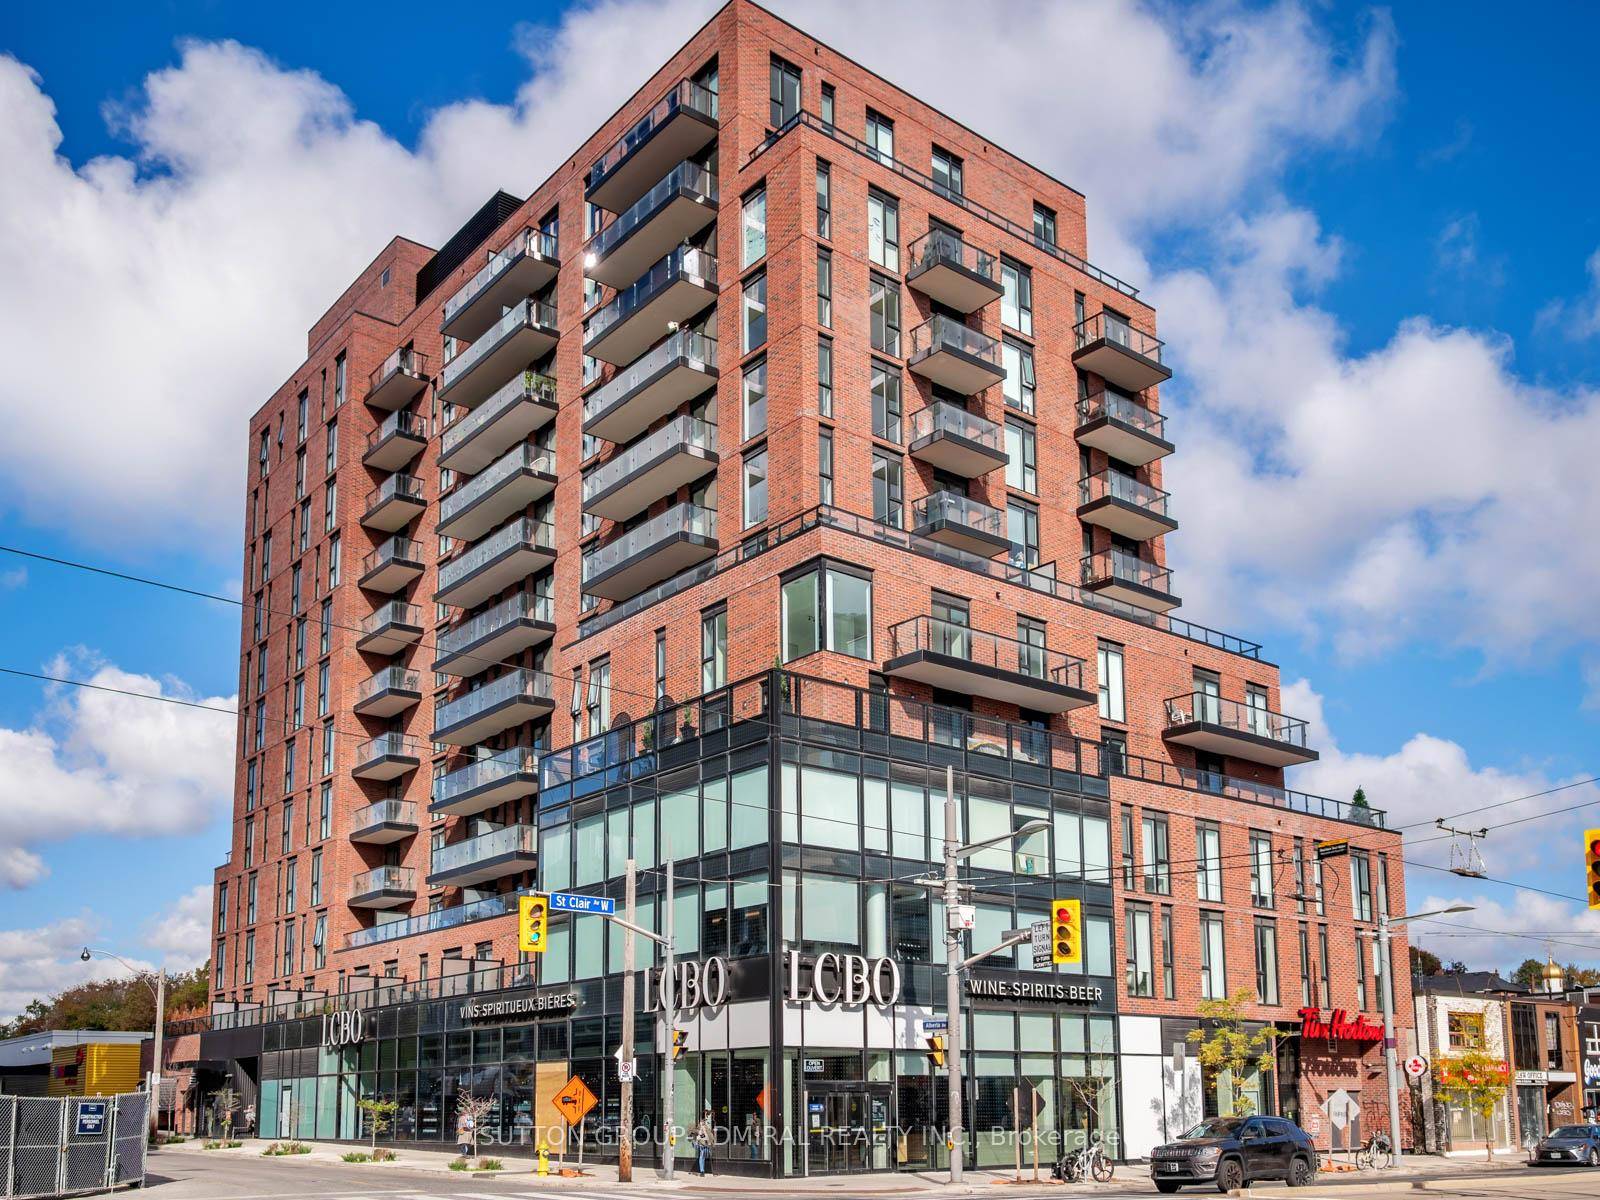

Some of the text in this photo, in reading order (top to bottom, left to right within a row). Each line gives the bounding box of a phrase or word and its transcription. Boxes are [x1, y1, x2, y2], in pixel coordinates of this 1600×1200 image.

[556, 895, 566, 907] St
[569, 897, 591, 909] Clair
[601, 901, 609, 911] W
[1034, 923, 1050, 933] LEFT
[1034, 934, 1050, 943] TURN
[643, 956, 725, 1014] LCBO
[788, 949, 901, 1007] LCBO
[970, 980, 1103, 1001] WINE SPIRITS BEER
[460, 992, 573, 1019] VINS SPIRITUEUX BIÈRES
[322, 1008, 362, 1047] LCBO
